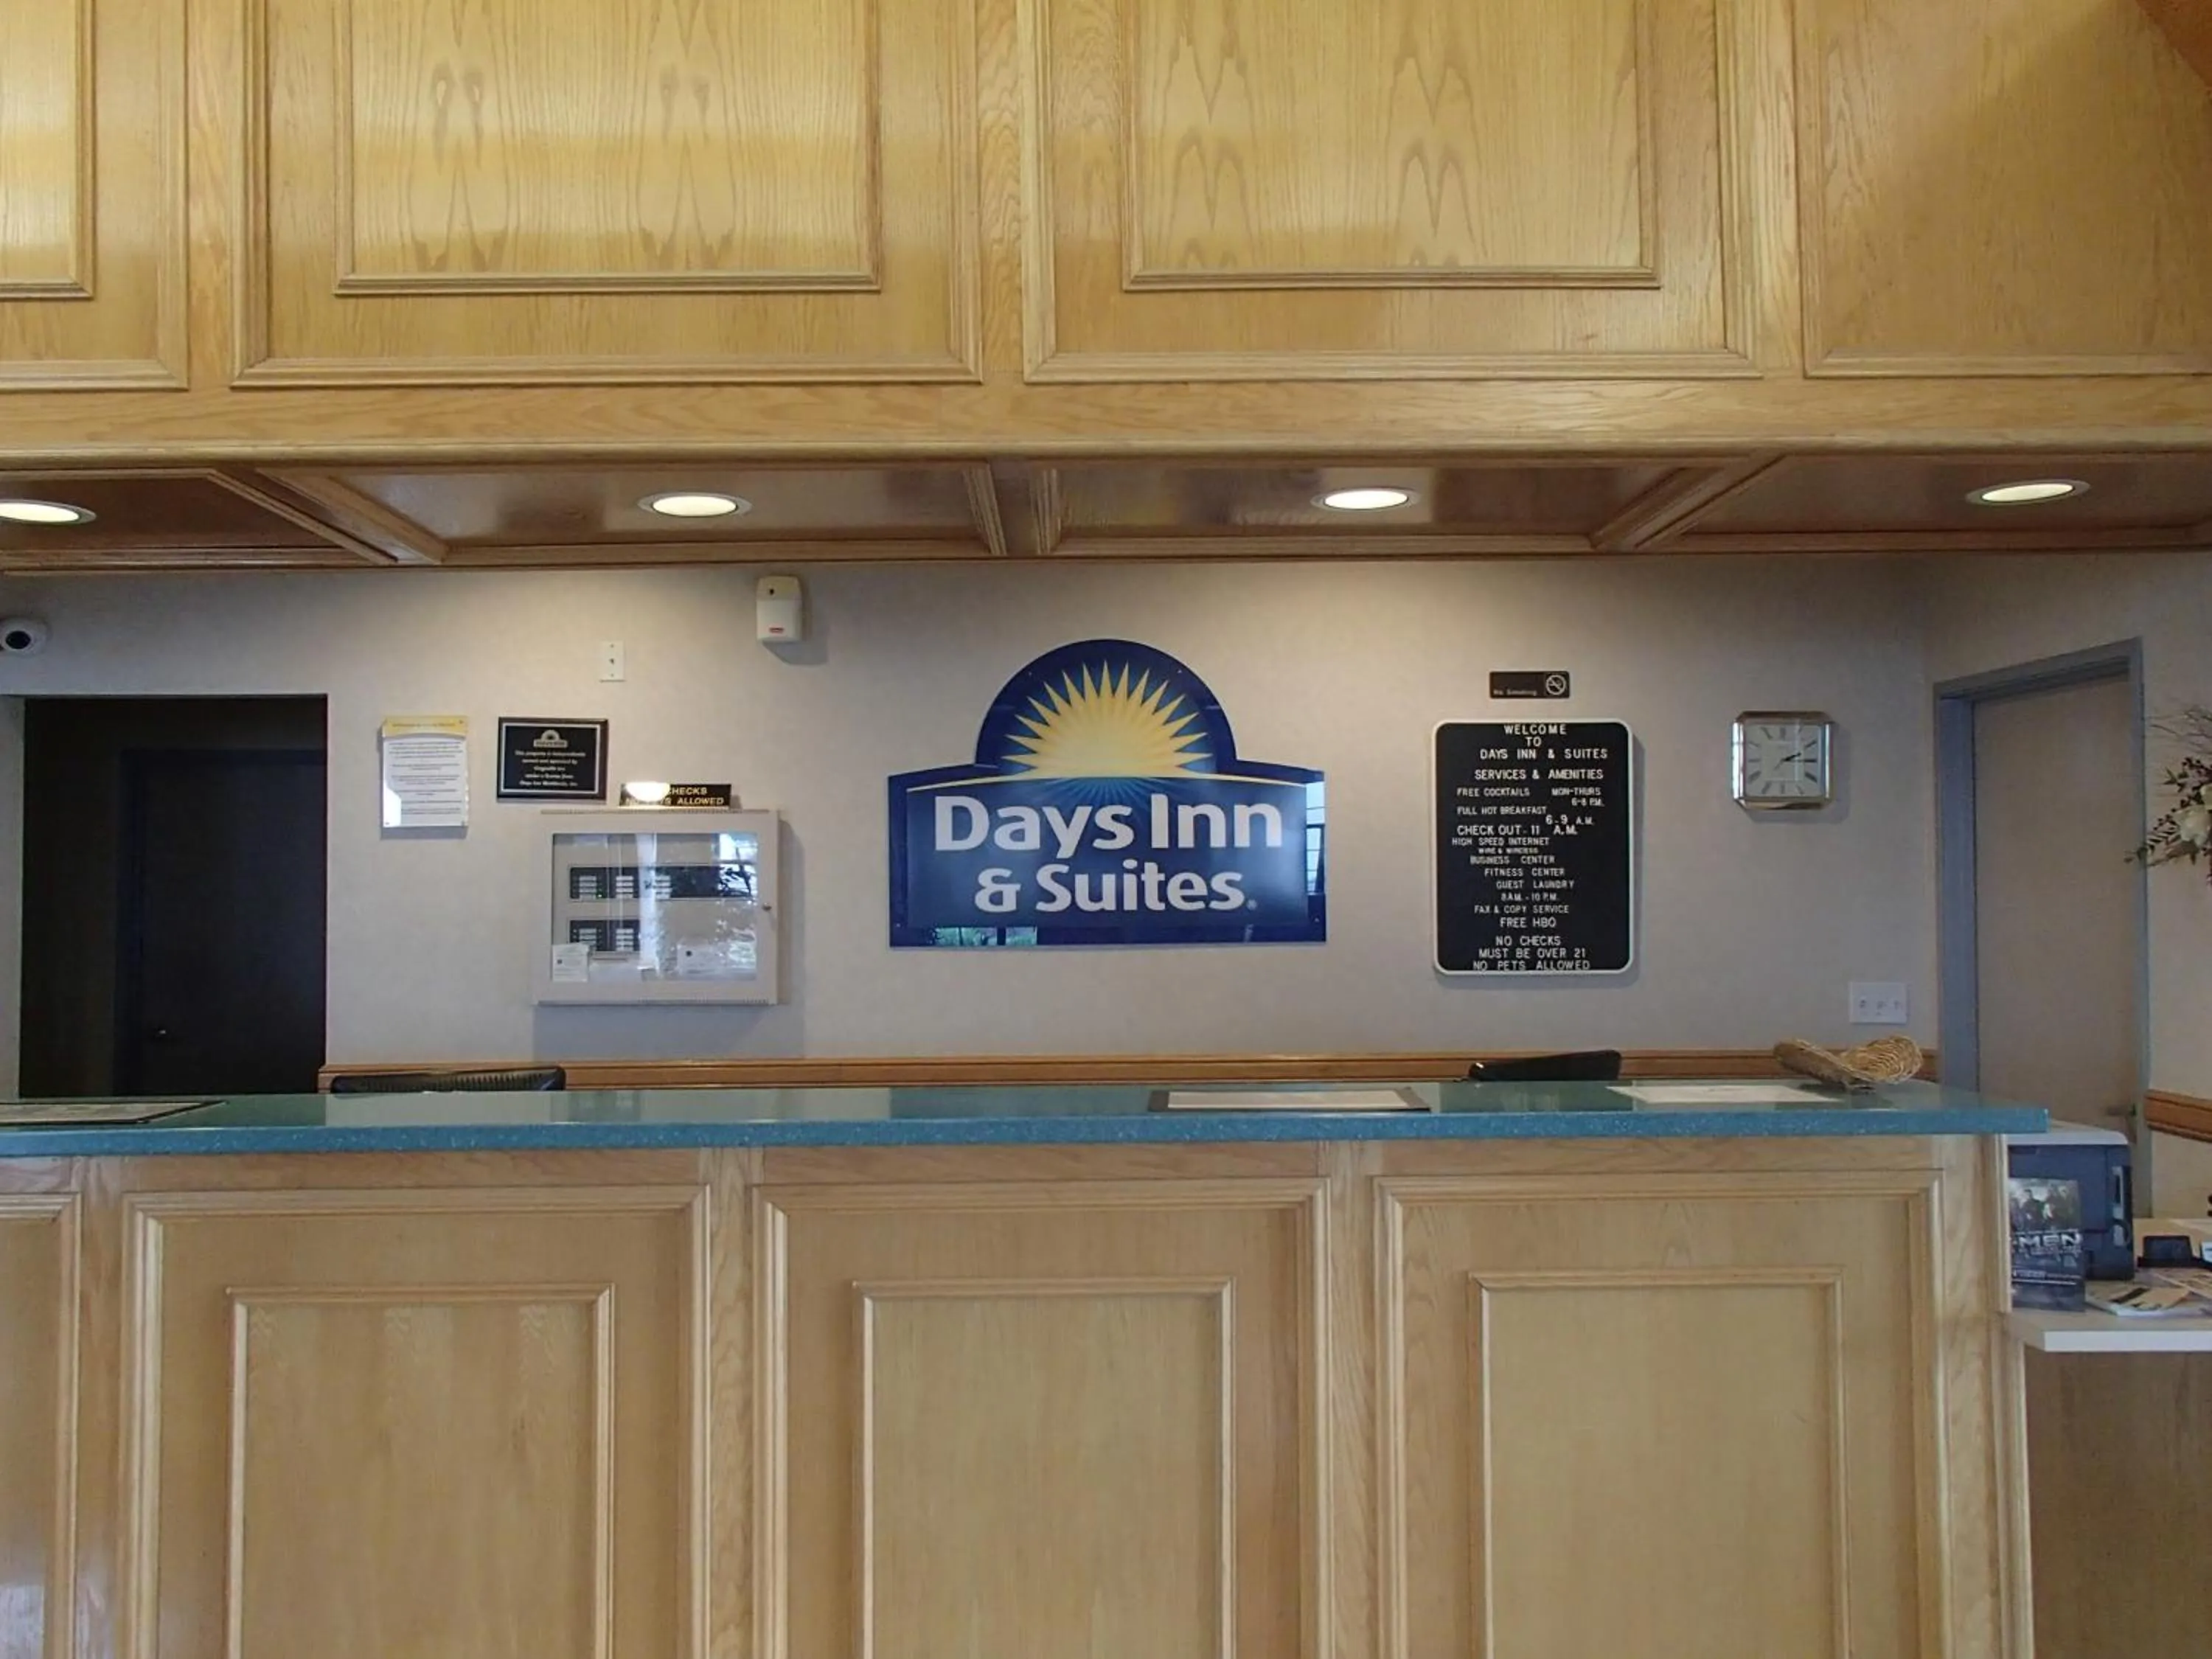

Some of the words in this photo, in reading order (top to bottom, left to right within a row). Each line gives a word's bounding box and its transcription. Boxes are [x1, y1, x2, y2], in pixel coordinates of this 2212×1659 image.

[1504, 724, 1566, 734] WELCOME
[1526, 737, 1542, 747] TO
[1480, 749, 1508, 759] DAYS
[1517, 749, 1537, 759] INN
[1548, 748, 1554, 759] &
[1565, 748, 1607, 759] SUITES
[1475, 769, 1526, 780] SERVICES
[1532, 769, 1540, 779] &
[1548, 769, 1603, 779] AMENITIES
[1457, 787, 1479, 796] FREE
[1484, 787, 1530, 796] COCKTAILS
[1457, 807, 1478, 815] FULL
[1481, 807, 1497, 815] HOT
[1500, 806, 1547, 815] BREAKFAST
[934, 795, 1135, 860] Days
[1150, 793, 1282, 849] Inn
[1457, 824, 1494, 835] CHECK
[1452, 838, 1472, 846] HIGH
[1478, 837, 1504, 846] SPEED
[1509, 837, 1549, 845] INTERNET
[1470, 855, 1509, 864] BUSINESS
[1521, 855, 1554, 864] CENTER
[1484, 868, 1523, 877] FITNESS
[1531, 868, 1564, 876] CENTER
[974, 868, 1021, 913] &
[1035, 858, 1245, 912] Suites
[1496, 880, 1524, 889] GUEST
[1534, 880, 1574, 888] LAUNDRY
[1494, 905, 1499, 914] &
[1504, 905, 1526, 914] COPY
[1534, 905, 1568, 914] SERVICE
[1500, 917, 1526, 928] FREE
[1533, 917, 1556, 928] HBO
[1496, 936, 1512, 946] NO
[1520, 936, 1561, 946] CHECKS
[1479, 948, 1509, 959] MUST
[1516, 948, 1530, 959] BE
[1537, 948, 1566, 958] OVER
[1574, 948, 1585, 958] 21
[1473, 960, 1487, 970] NO
[1498, 960, 1526, 970] PETS
[1537, 960, 1590, 970] ALLOWED
